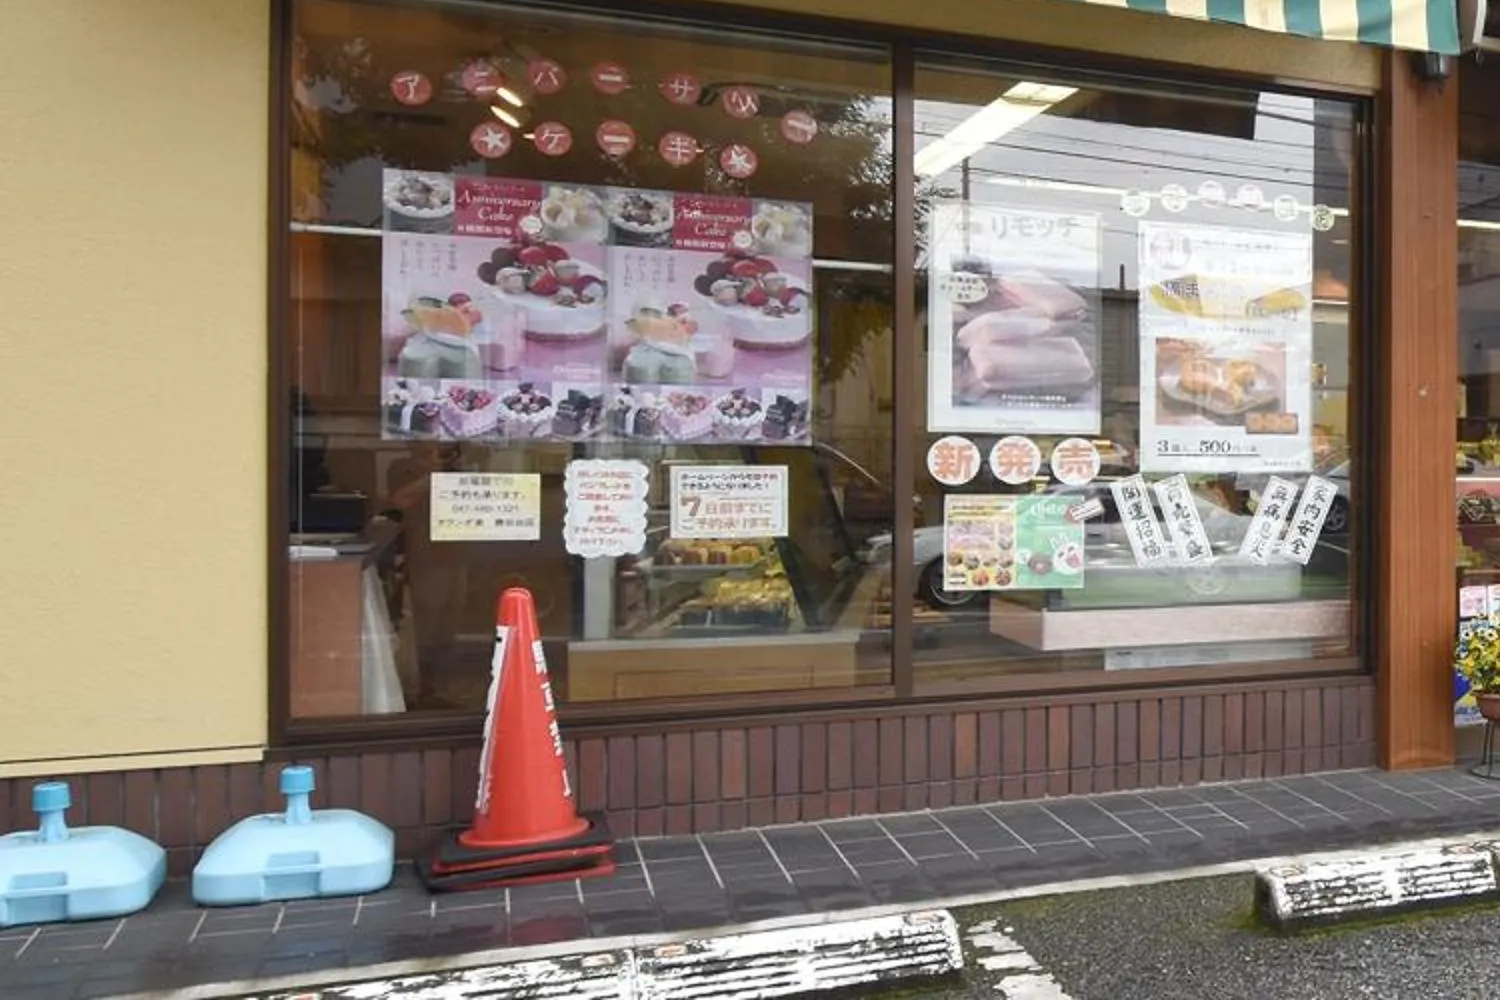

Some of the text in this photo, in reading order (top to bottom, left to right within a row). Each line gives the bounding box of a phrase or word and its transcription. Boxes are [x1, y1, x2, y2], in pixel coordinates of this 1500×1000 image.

[392, 62, 819, 138] アニバーサリー
[933, 441, 1095, 481] 新発売
